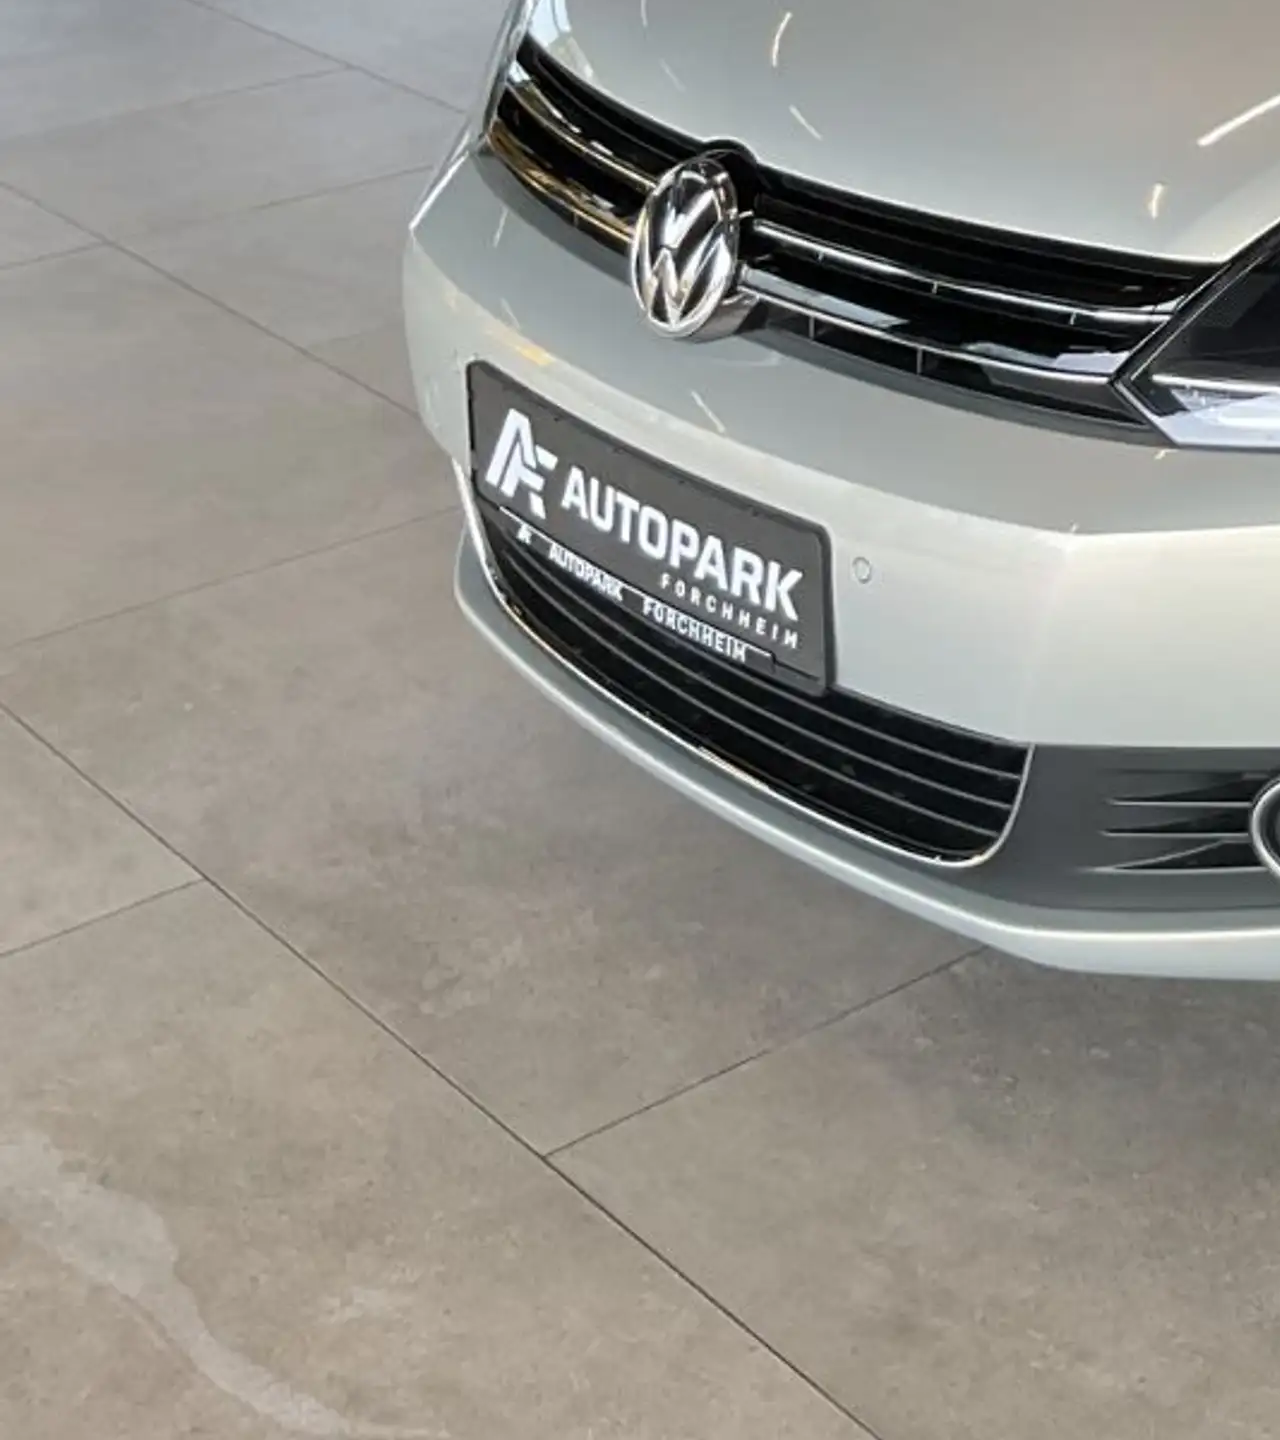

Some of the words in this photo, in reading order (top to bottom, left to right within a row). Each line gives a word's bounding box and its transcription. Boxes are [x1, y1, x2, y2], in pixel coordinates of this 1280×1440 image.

[549, 542, 625, 602] AUTOPARK
[643, 597, 747, 663] FORCHHEIM
[561, 465, 803, 621] AUTOPARK
[661, 573, 799, 649] FORCHHEIM
